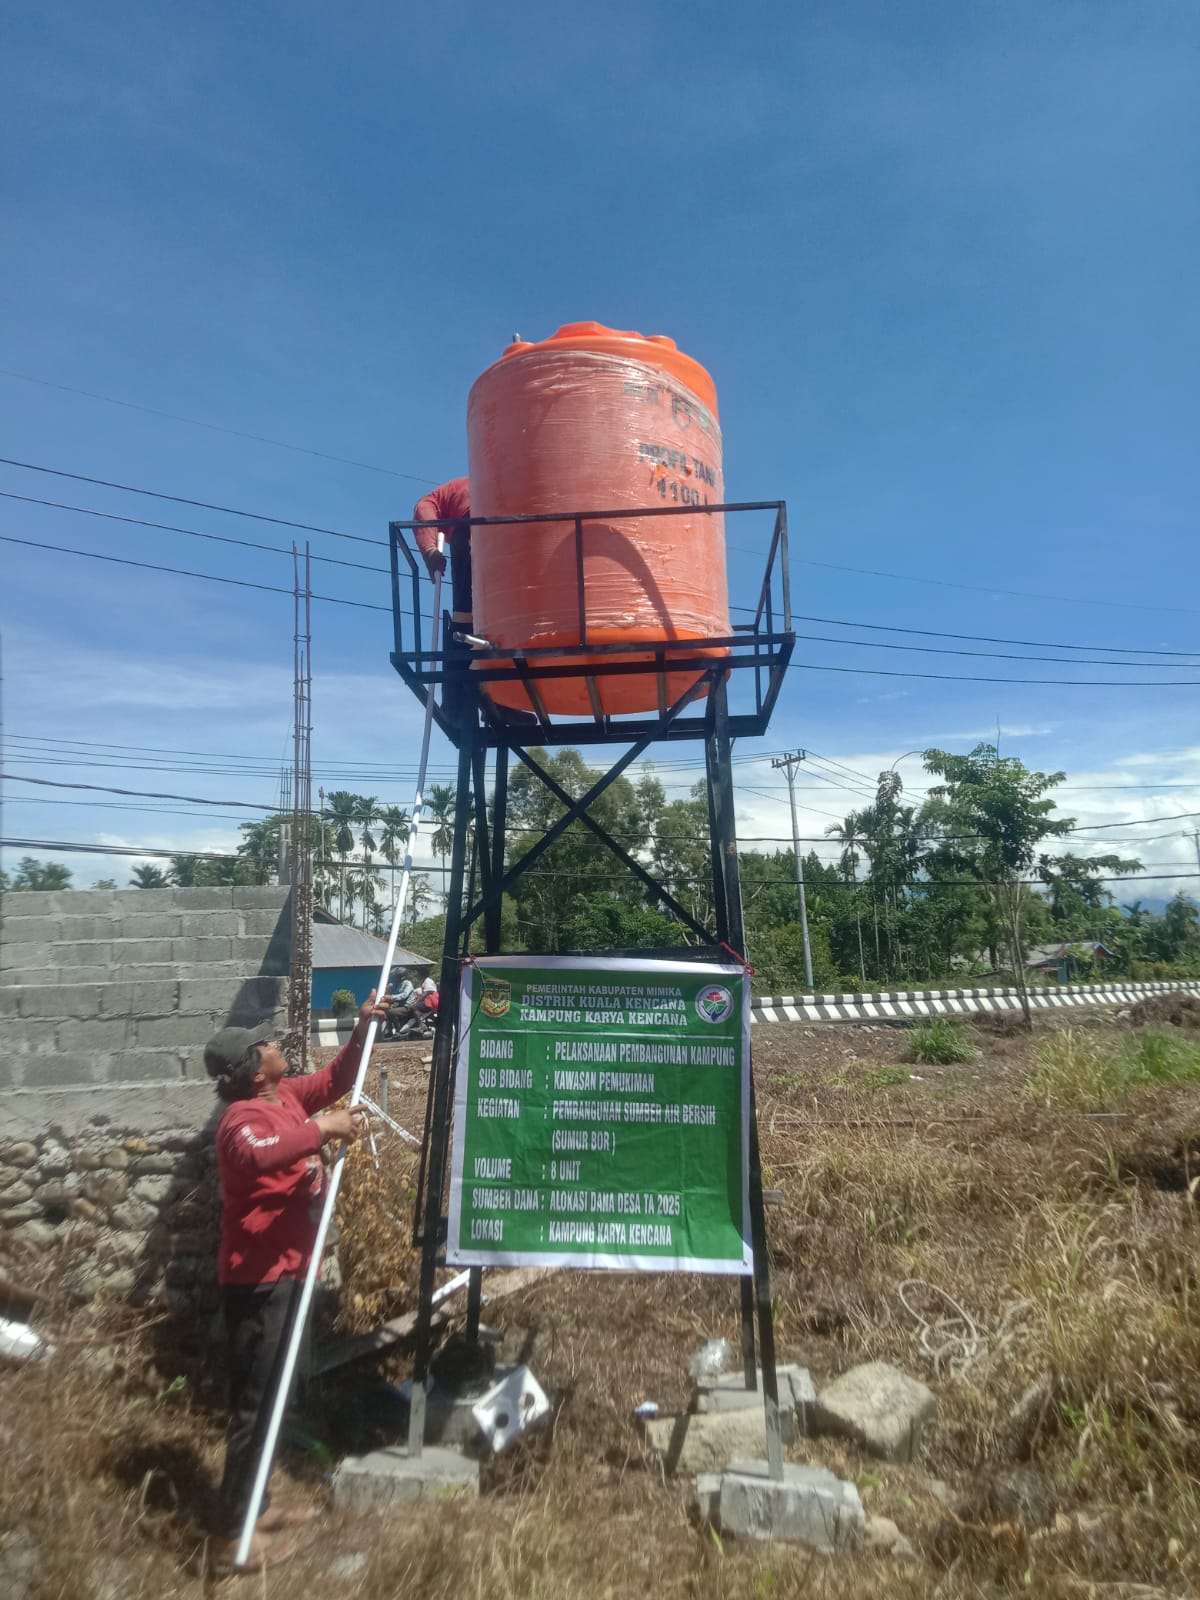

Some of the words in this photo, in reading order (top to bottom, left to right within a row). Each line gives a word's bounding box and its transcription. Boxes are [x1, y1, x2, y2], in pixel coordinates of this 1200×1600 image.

[527, 984, 586, 994] PEMERINTAH
[589, 986, 644, 995] KABUPATEN
[646, 986, 681, 996] MIMIKA
[522, 995, 574, 1007] DISTRIK
[580, 997, 620, 1008] KUALA
[625, 998, 686, 1010] KENCANA
[520, 1009, 580, 1023] KAMPUNG
[585, 1011, 624, 1023] KARYA
[628, 1012, 687, 1025] KENCANA
[480, 1040, 513, 1058] BIDANG
[555, 1042, 616, 1062] PELAKSANAAN
[620, 1044, 687, 1064] PEMBANGUNAN
[691, 1046, 735, 1066] KAMPUNG
[479, 1069, 496, 1087] SUB
[500, 1070, 532, 1088] BIDANG
[554, 1072, 596, 1091] KAWASAN
[599, 1072, 655, 1093] PEMUKIMAN
[478, 1099, 519, 1119] KEGIATAN
[553, 1101, 621, 1121] PEMBANGUNAN
[624, 1103, 661, 1122] SUMBER
[665, 1104, 679, 1123] AIR
[682, 1105, 715, 1125] BERSIH
[552, 1131, 588, 1153] (SUMUR
[474, 1158, 511, 1179] VOLUME
[551, 1162, 556, 1178] 8
[559, 1161, 581, 1181] UNIT
[472, 1189, 511, 1209] SUMBER
[514, 1191, 538, 1210] DANA
[550, 1191, 587, 1212] ALOKASI
[591, 1192, 614, 1212] DANA
[617, 1194, 641, 1213] DESA
[644, 1195, 655, 1214] TA
[657, 1195, 680, 1216] 2025
[471, 1220, 503, 1240] LOKASI
[549, 1222, 594, 1243] KAMPUNG
[597, 1223, 626, 1244] KARYA
[629, 1224, 672, 1246] KENCANA
